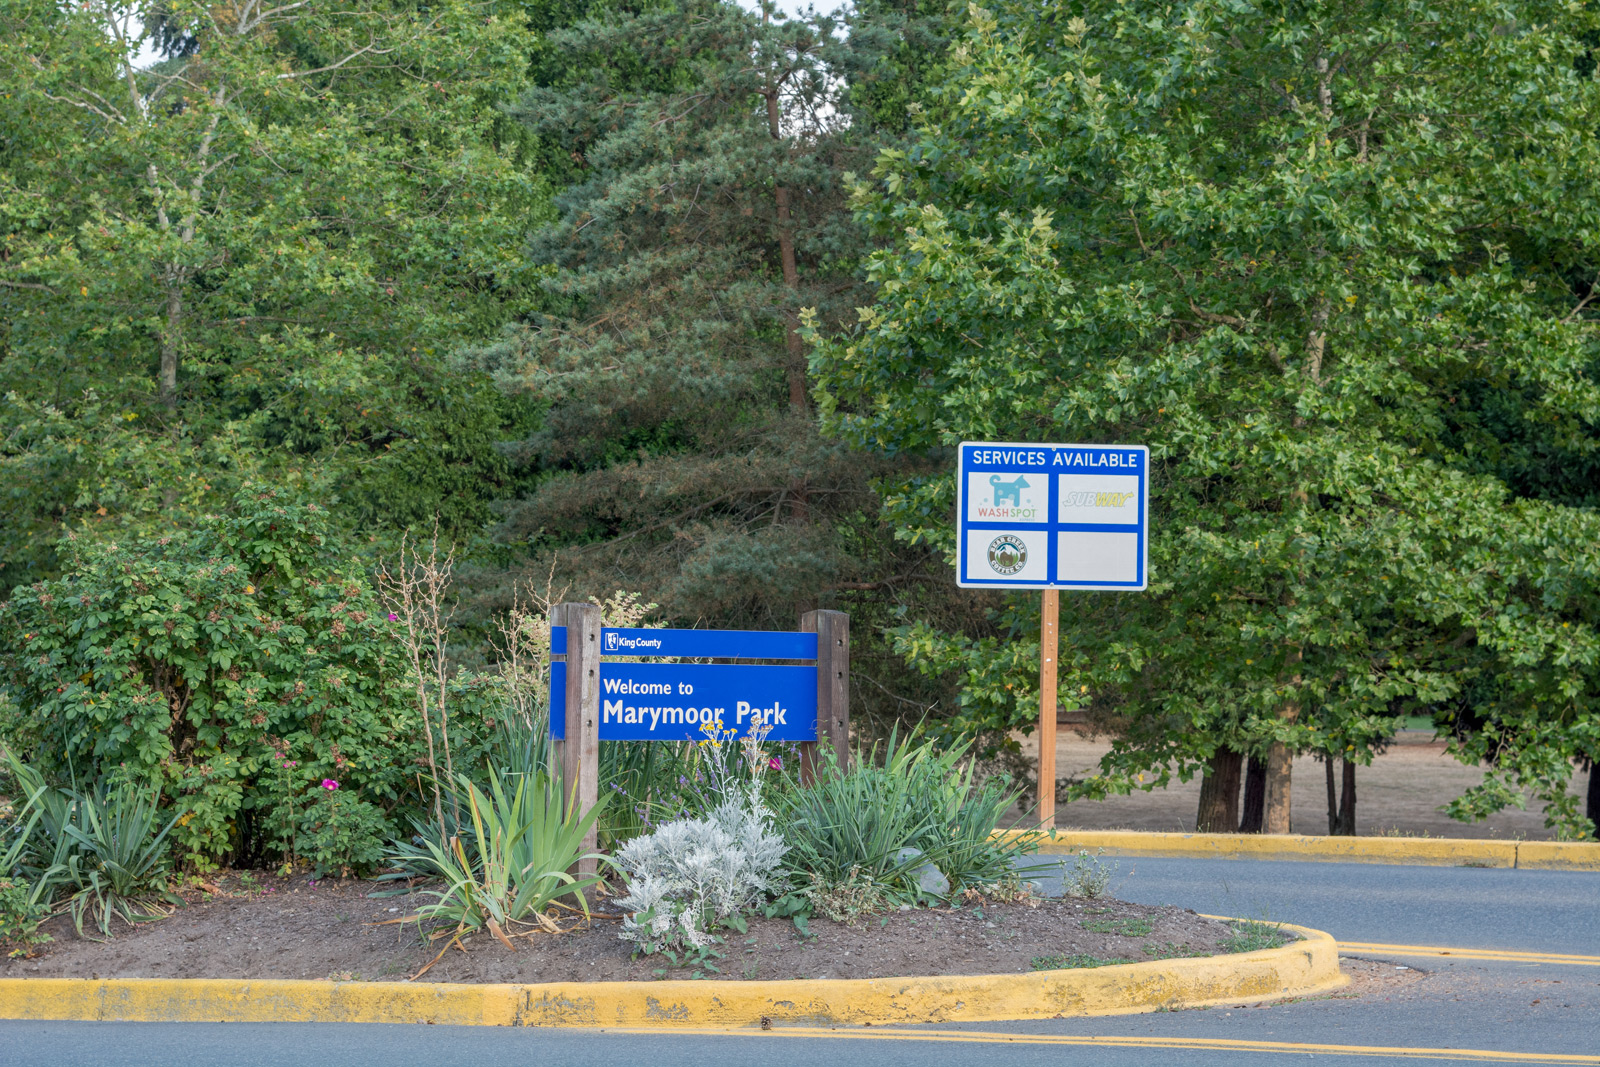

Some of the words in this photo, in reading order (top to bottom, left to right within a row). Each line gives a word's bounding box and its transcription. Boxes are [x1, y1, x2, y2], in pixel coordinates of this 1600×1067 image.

[973, 450, 1046, 466] SERVICES
[1052, 452, 1138, 468] AVAILABLE
[1063, 491, 1134, 508] SUBWAY
[618, 637, 635, 649] King
[636, 637, 662, 649] County
[603, 678, 671, 695] Welcome
[678, 681, 693, 695] to
[603, 699, 724, 731] Marymoor
[736, 701, 787, 725] Park
